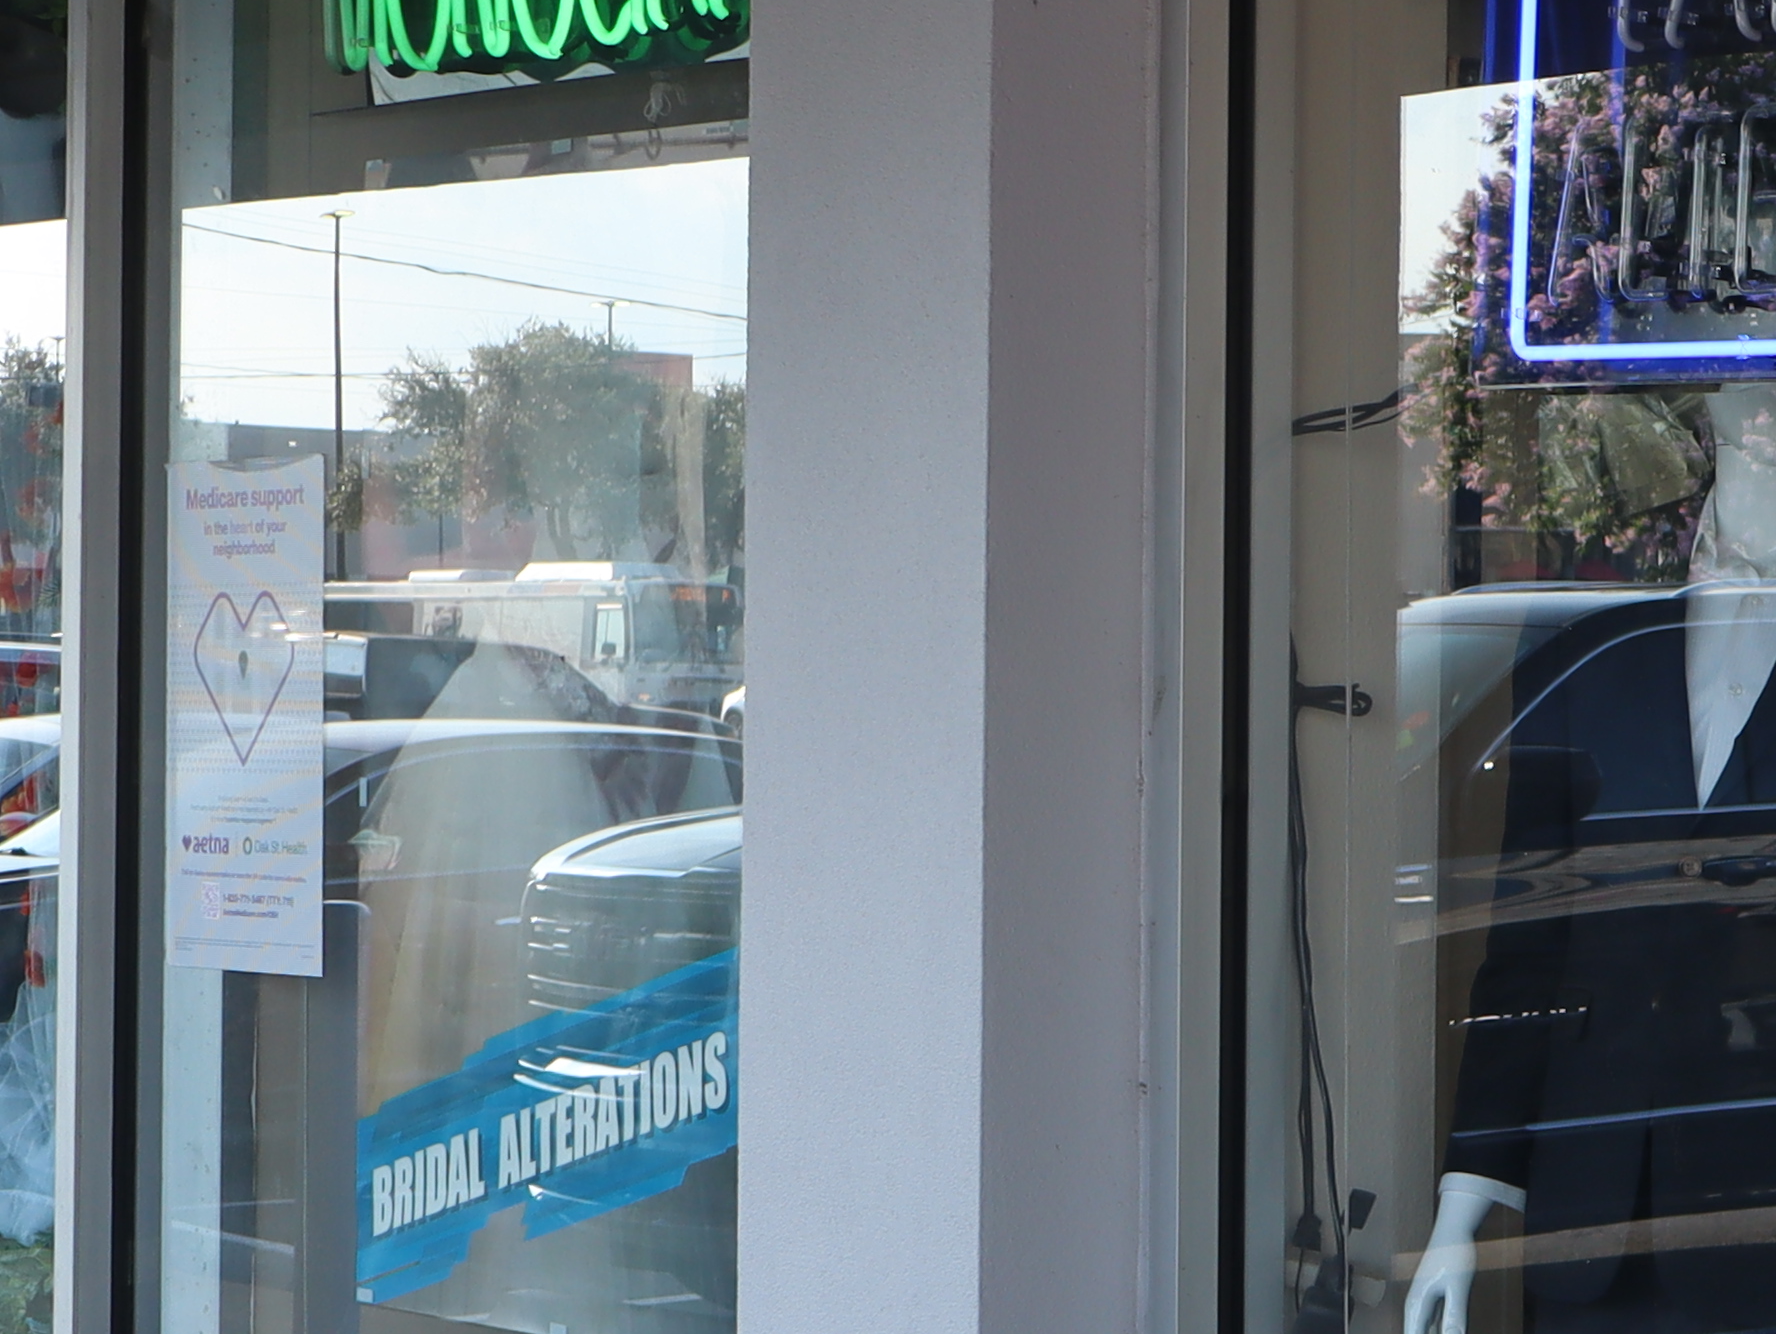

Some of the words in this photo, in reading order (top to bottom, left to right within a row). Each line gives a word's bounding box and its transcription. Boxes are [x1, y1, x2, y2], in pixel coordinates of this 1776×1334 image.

[186, 486, 248, 510] Medicare
[251, 484, 304, 511] support
[213, 540, 275, 559] neighborhood
[192, 833, 229, 854] aetna
[372, 1127, 486, 1238] BRIDAL
[498, 1030, 728, 1190] ALTERATIONS
